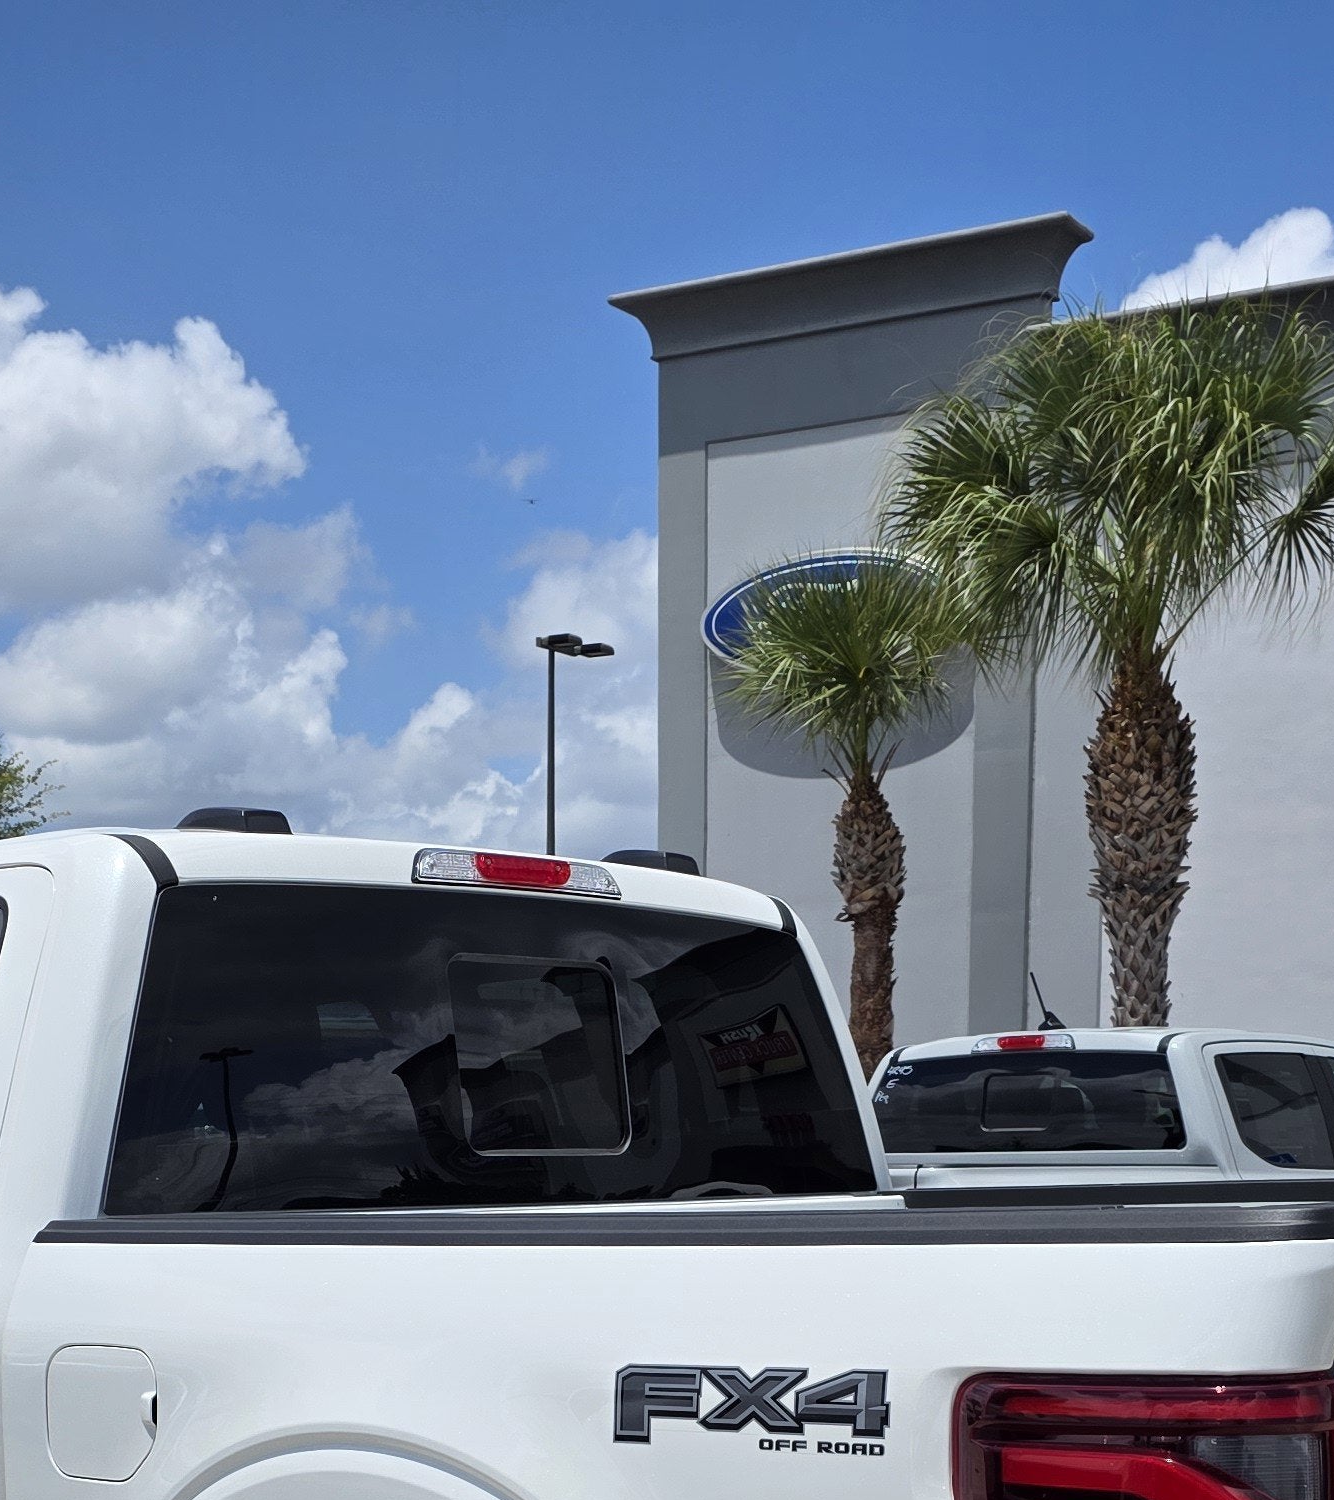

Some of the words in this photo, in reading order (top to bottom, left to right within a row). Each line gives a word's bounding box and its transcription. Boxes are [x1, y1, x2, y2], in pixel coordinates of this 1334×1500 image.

[613, 1363, 891, 1444] FX4
[759, 1439, 808, 1452] OFF
[817, 1441, 885, 1456] ROAD
